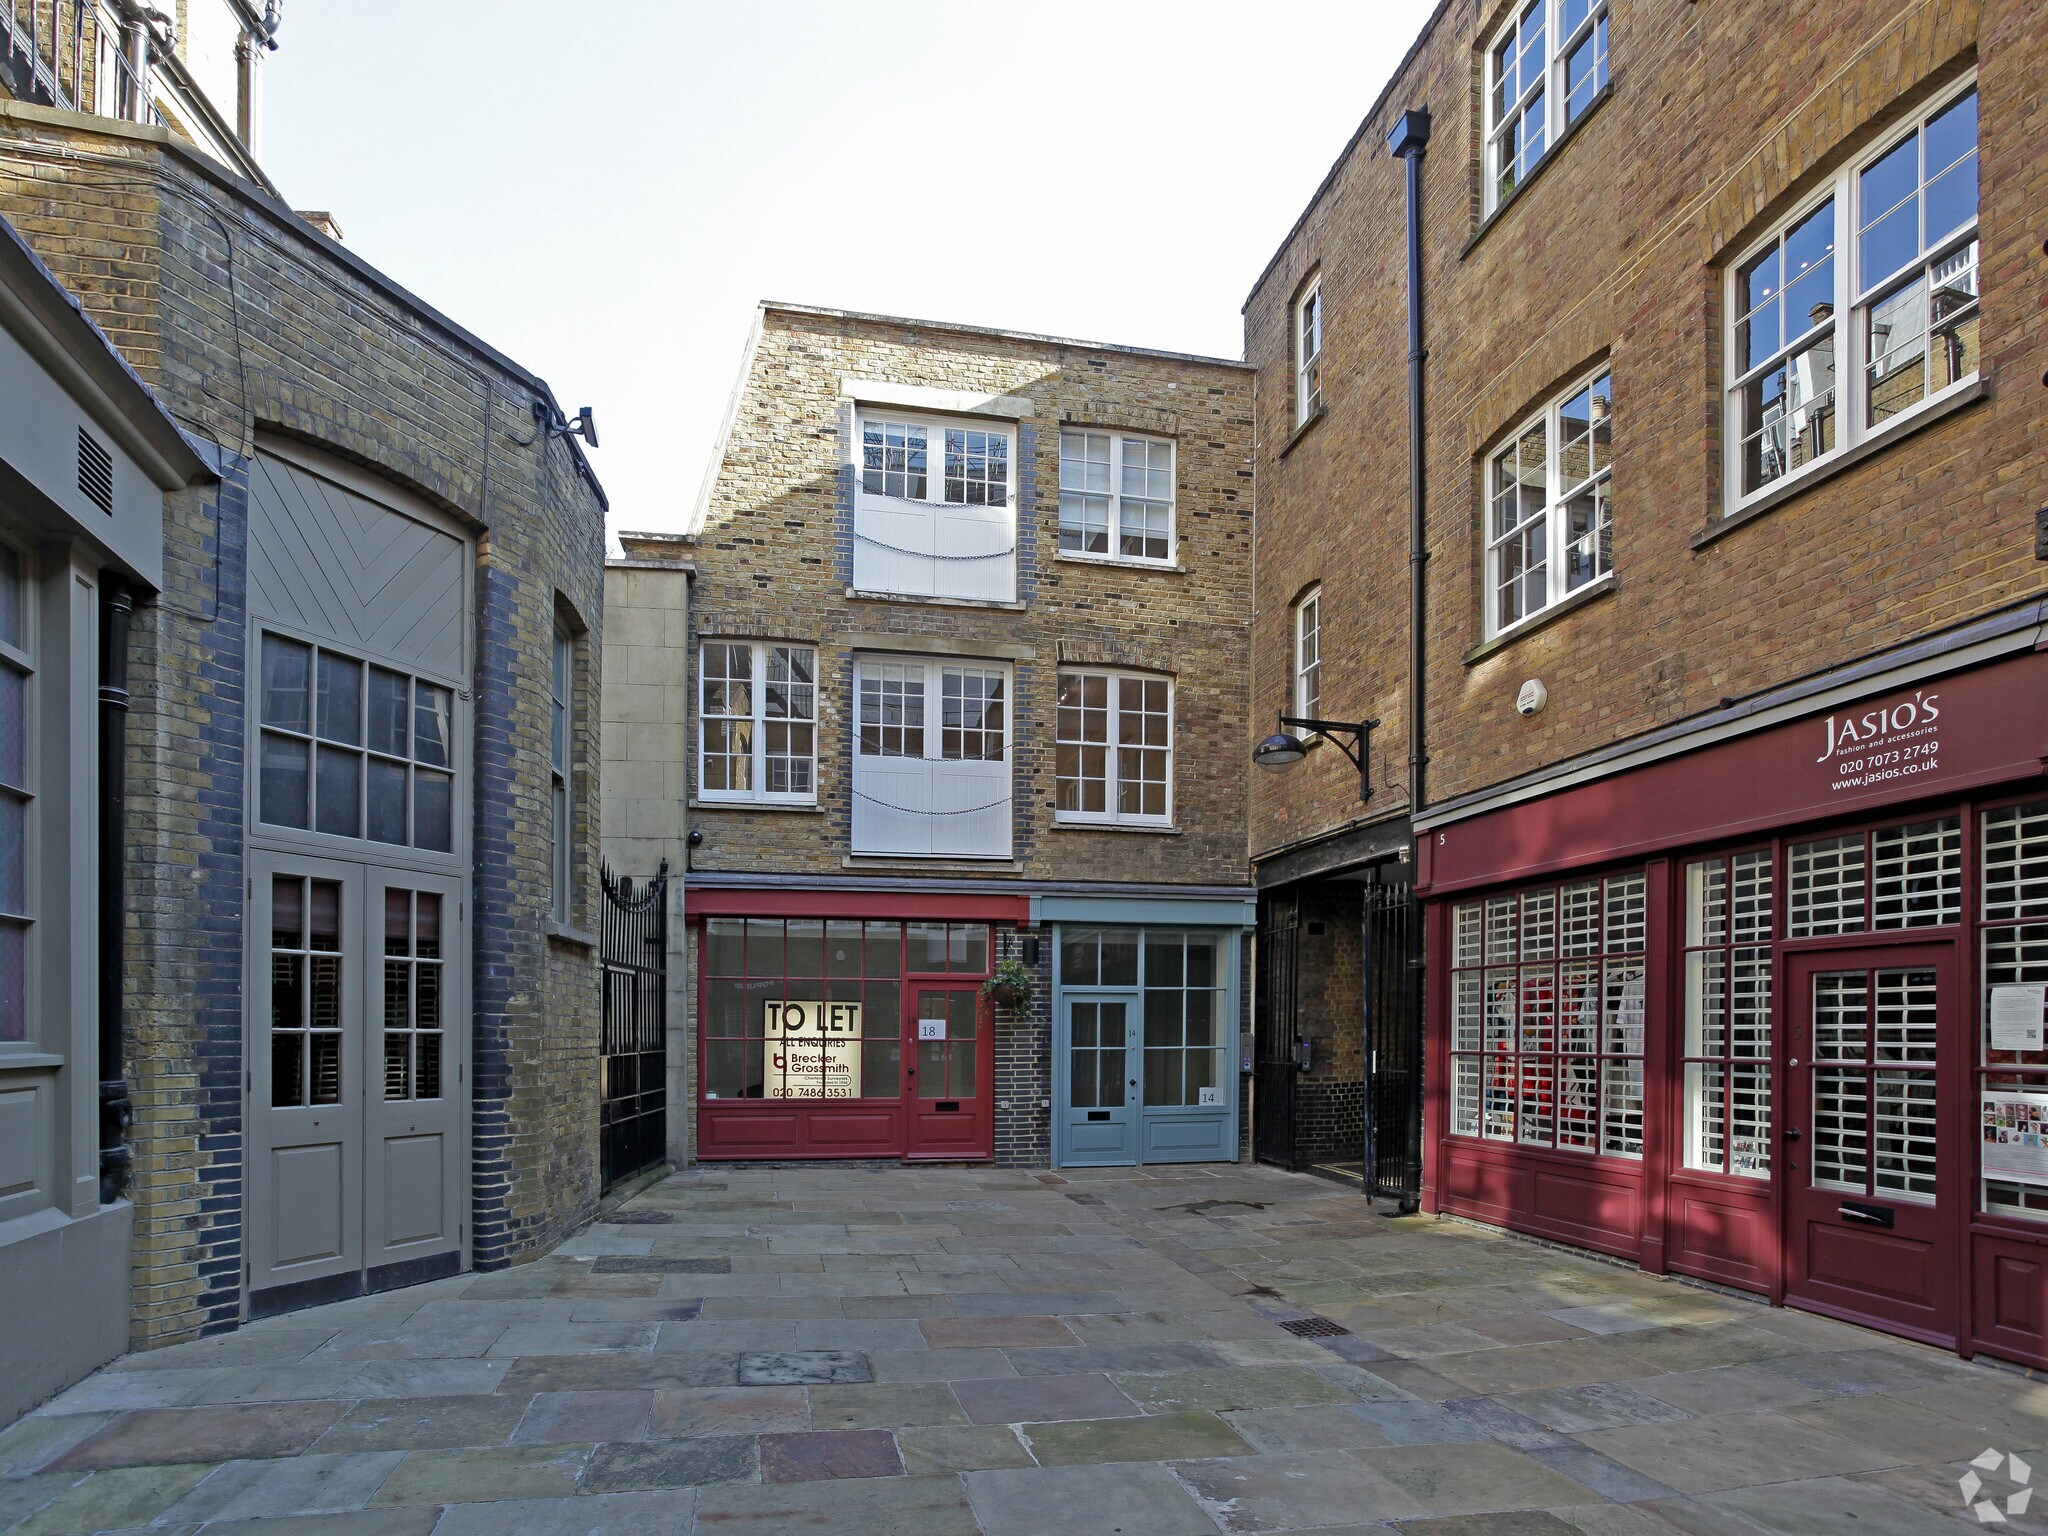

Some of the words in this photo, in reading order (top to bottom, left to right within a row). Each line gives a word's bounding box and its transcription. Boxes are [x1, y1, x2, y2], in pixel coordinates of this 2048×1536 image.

[1816, 690, 1939, 763] JASIO'S
[1836, 742, 1865, 756] fashion
[1869, 738, 1884, 748] and
[1887, 725, 1938, 744] accessories
[1840, 759, 1864, 775] 020
[1866, 750, 1899, 769] 7073
[1903, 740, 1939, 761] 2749
[1831, 757, 1938, 791] www.jasios.co.uk
[1440, 833, 1445, 845] 5
[768, 1003, 805, 1031] TO
[817, 1005, 858, 1031] LET
[922, 1026, 936, 1037] 18
[1128, 1029, 1136, 1037] 14
[791, 1054, 837, 1063] Brecker
[791, 1063, 850, 1073] Grossmith
[772, 1087, 793, 1098] 020
[798, 1088, 824, 1098] 7486
[827, 1088, 852, 1098] 3531
[1202, 1093, 1215, 1103] 14
